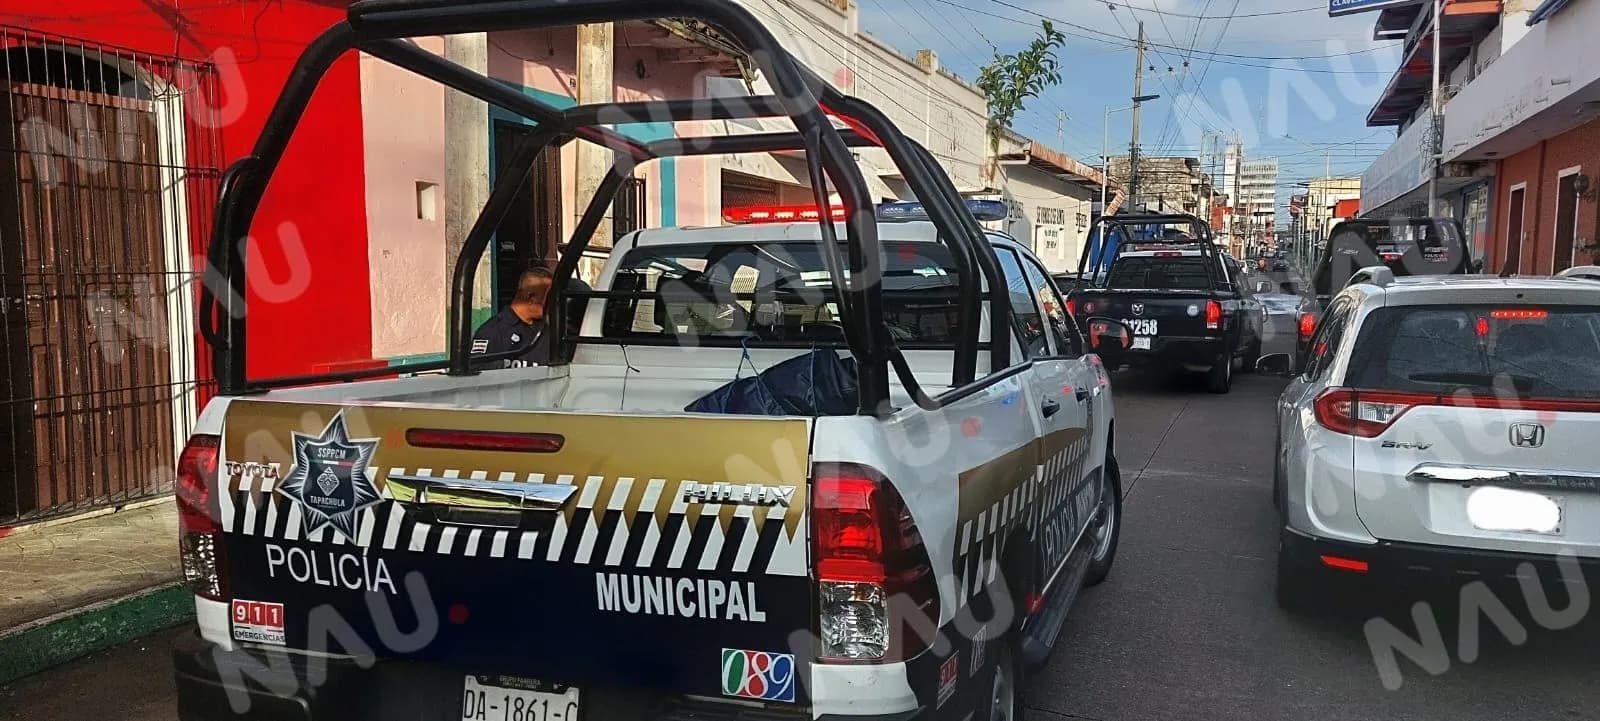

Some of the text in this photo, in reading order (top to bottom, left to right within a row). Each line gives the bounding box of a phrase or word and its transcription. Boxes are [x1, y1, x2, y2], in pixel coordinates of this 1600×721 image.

[317, 447, 347, 460] SSPPCM
[225, 462, 281, 479] TOYOTA
[310, 495, 346, 507] TAPACHULA
[683, 484, 794, 508] HILUX
[265, 544, 398, 594] POLICÍA
[595, 572, 767, 623] MUNICIPAL
[236, 604, 279, 625] 911
[234, 630, 286, 643] EMERGENCIAS
[723, 650, 795, 699] 089
[463, 689, 578, 721] DA-1861-C
